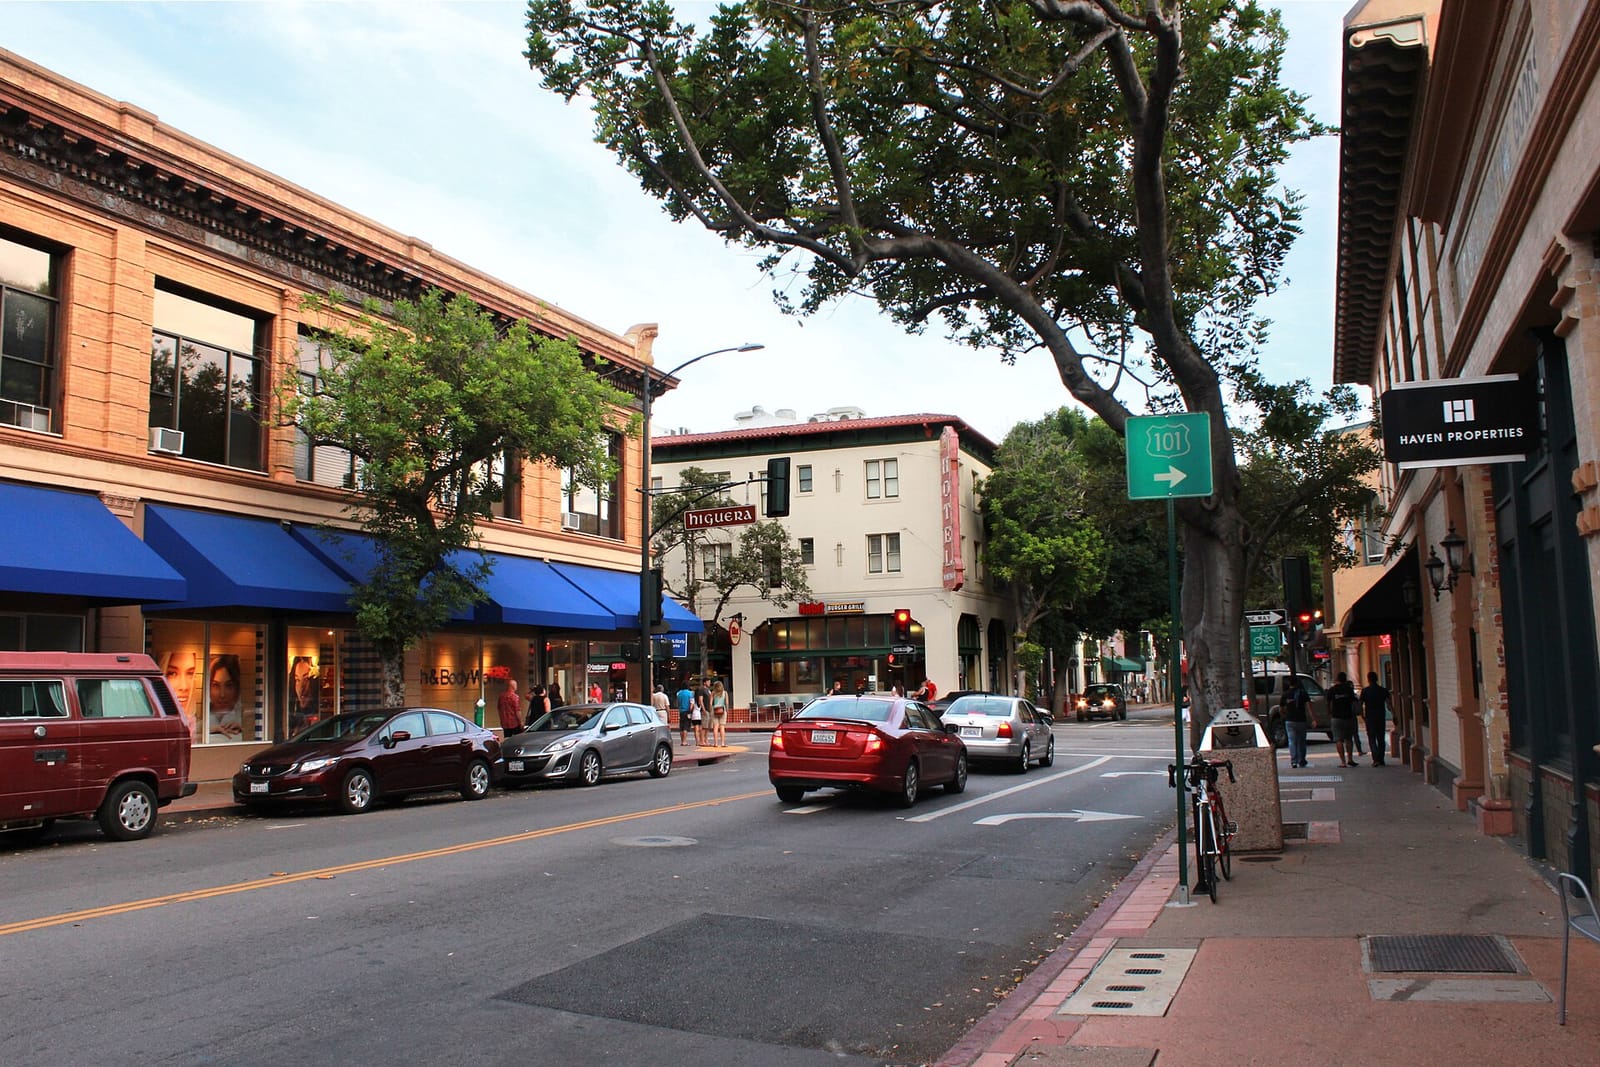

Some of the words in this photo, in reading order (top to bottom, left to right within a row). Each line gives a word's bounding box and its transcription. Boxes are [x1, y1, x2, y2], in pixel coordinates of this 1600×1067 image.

[1154, 431, 1181, 452] 101
[1400, 431, 1443, 445] HAVEN
[1447, 427, 1524, 442] PROPERTIES
[942, 455, 955, 568] HOTEL
